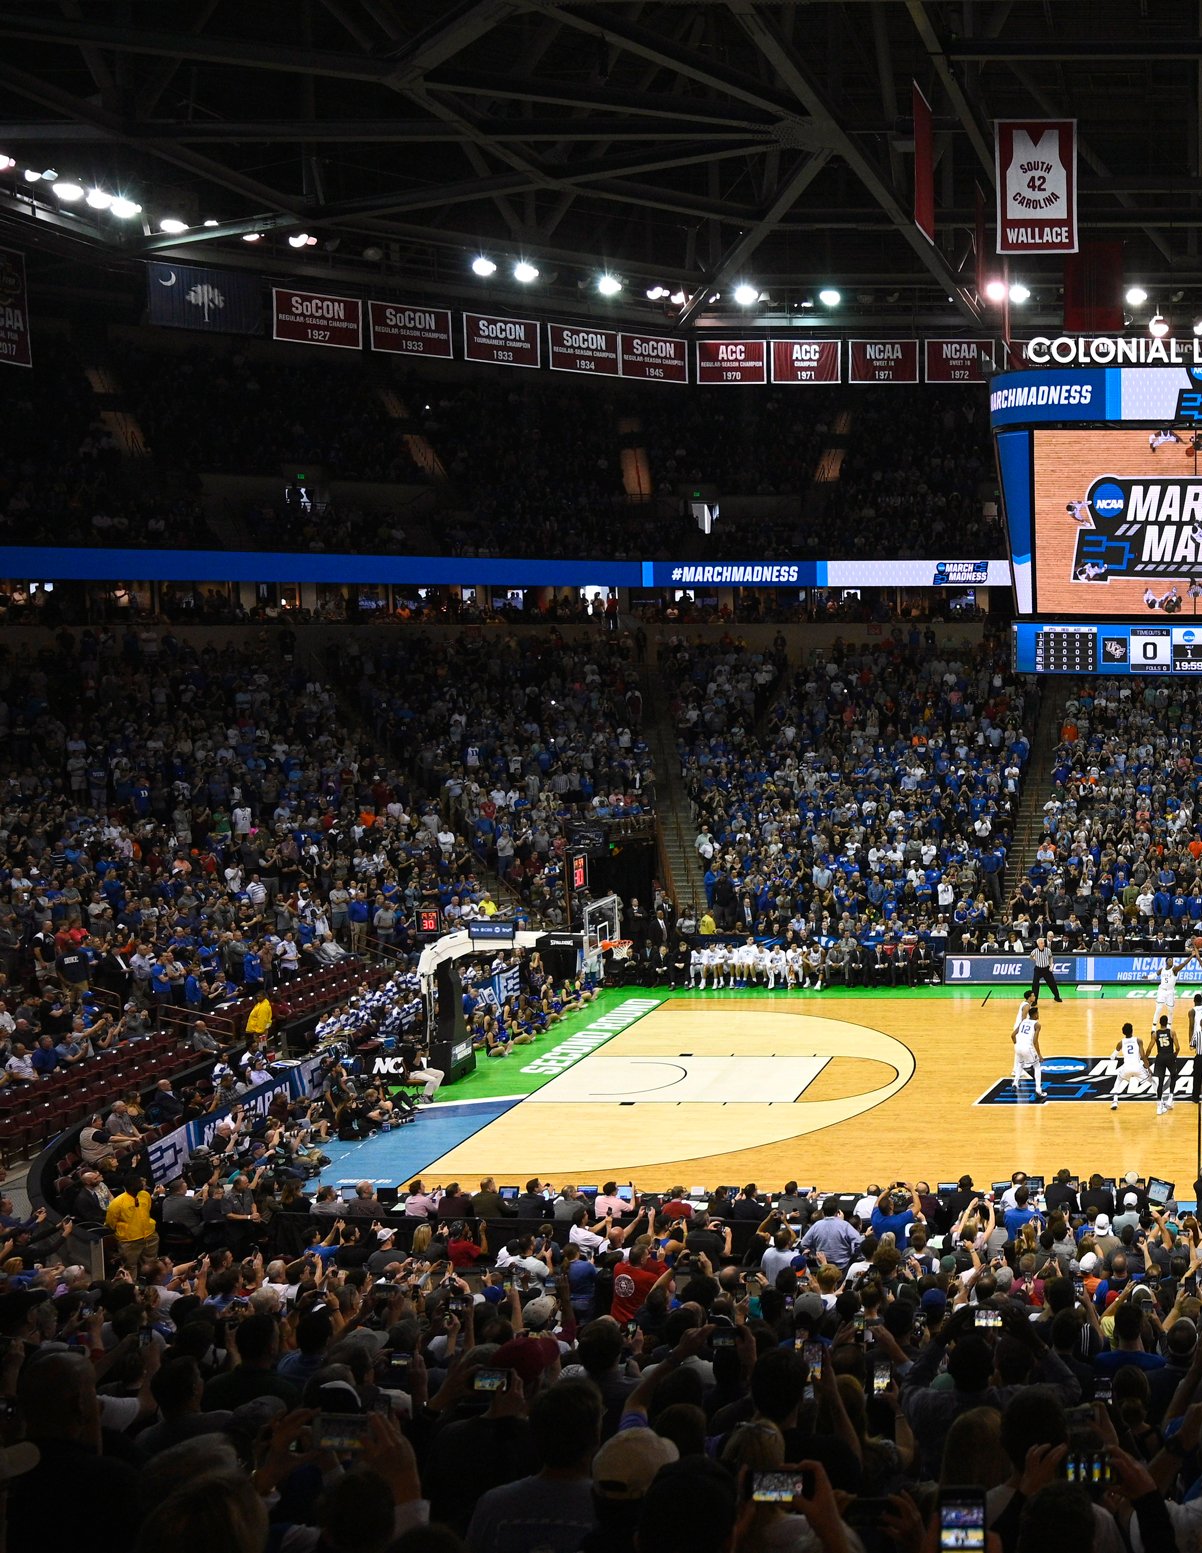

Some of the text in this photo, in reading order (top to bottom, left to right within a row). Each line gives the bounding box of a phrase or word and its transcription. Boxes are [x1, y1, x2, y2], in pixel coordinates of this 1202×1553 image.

[1019, 160, 1053, 175] SOUTH
[1027, 176, 1047, 192] 42
[1012, 191, 1060, 209] CAROLINA
[1006, 227, 1069, 244] WALLACE
[291, 296, 345, 319] SoCON
[279, 313, 357, 329] REGULAR-SEASON CHAMPION
[385, 308, 436, 330] SoCON
[307, 329, 330, 341] 1927
[375, 325, 448, 340] REGULAR-SEASON CHAMPION
[478, 320, 525, 341] SoCON
[401, 340, 424, 351] 1933
[474, 336, 531, 349] TOURNAMENT CHAMPION
[562, 330, 607, 350] SoCON
[493, 350, 513, 360] 1933
[553, 346, 616, 359] REGULAR-SEASON CHAMPION
[632, 339, 675, 358] SoCON
[718, 345, 745, 360] ACC
[792, 344, 820, 360] ACC
[866, 344, 903, 359] NCAA
[942, 343, 978, 359] NCAA
[1028, 337, 1182, 364] COLONIAL
[576, 359, 595, 370] 1934
[623, 354, 684, 367] REGULAR-SEASON CHAMPION
[645, 367, 664, 378] 1945
[723, 371, 741, 380] 1970
[797, 371, 815, 379] 1971
[875, 371, 893, 379] 1971
[950, 370, 970, 379] 1972
[1095, 498, 1124, 510] NCAA
[672, 566, 799, 582] #MARCHMADNESS
[945, 563, 974, 572] MARCH
[948, 572, 988, 581] MADNESS
[1142, 642, 1157, 661] 0
[1187, 650, 1192, 658] 1
[423, 920, 435, 930] 30
[951, 960, 971, 978] D
[992, 963, 1022, 975] DUKE
[1132, 957, 1166, 971] NCAA
[1020, 1024, 1031, 1035] 12
[520, 999, 661, 1075] SECOND ROUND
[1158, 1036, 1170, 1048] 15
[1127, 1044, 1134, 1055] 2
